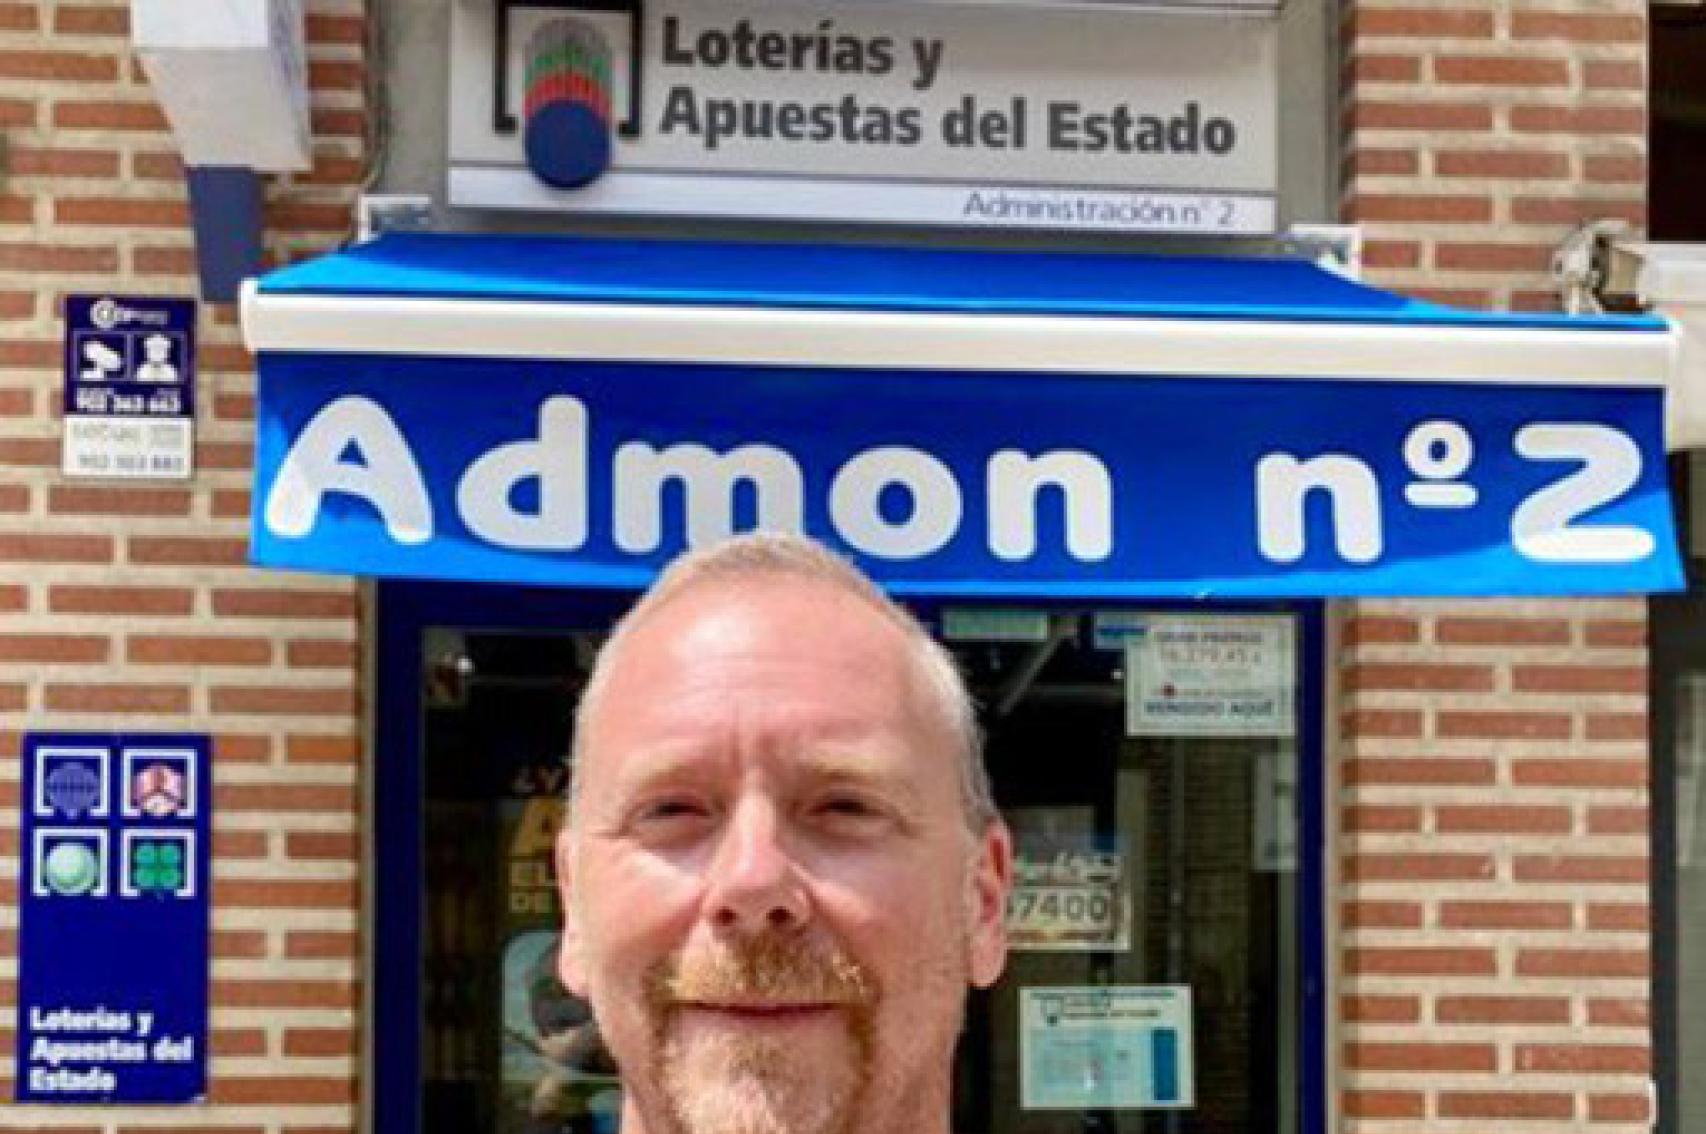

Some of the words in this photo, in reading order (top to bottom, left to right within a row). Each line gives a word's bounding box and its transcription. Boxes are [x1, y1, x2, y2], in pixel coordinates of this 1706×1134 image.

[661, 15, 894, 75] Loterías
[912, 37, 943, 89] y
[659, 87, 923, 149] Apuestas
[942, 96, 1027, 149] del
[1047, 102, 1236, 155] Estado
[963, 191, 1176, 224] Administración
[1216, 203, 1236, 225] 2
[262, 393, 1112, 563] Admon
[136, 1012, 154, 1037] y
[31, 1037, 147, 1066] Apuestas
[153, 1035, 195, 1061] del
[29, 1067, 117, 1092] Estado
